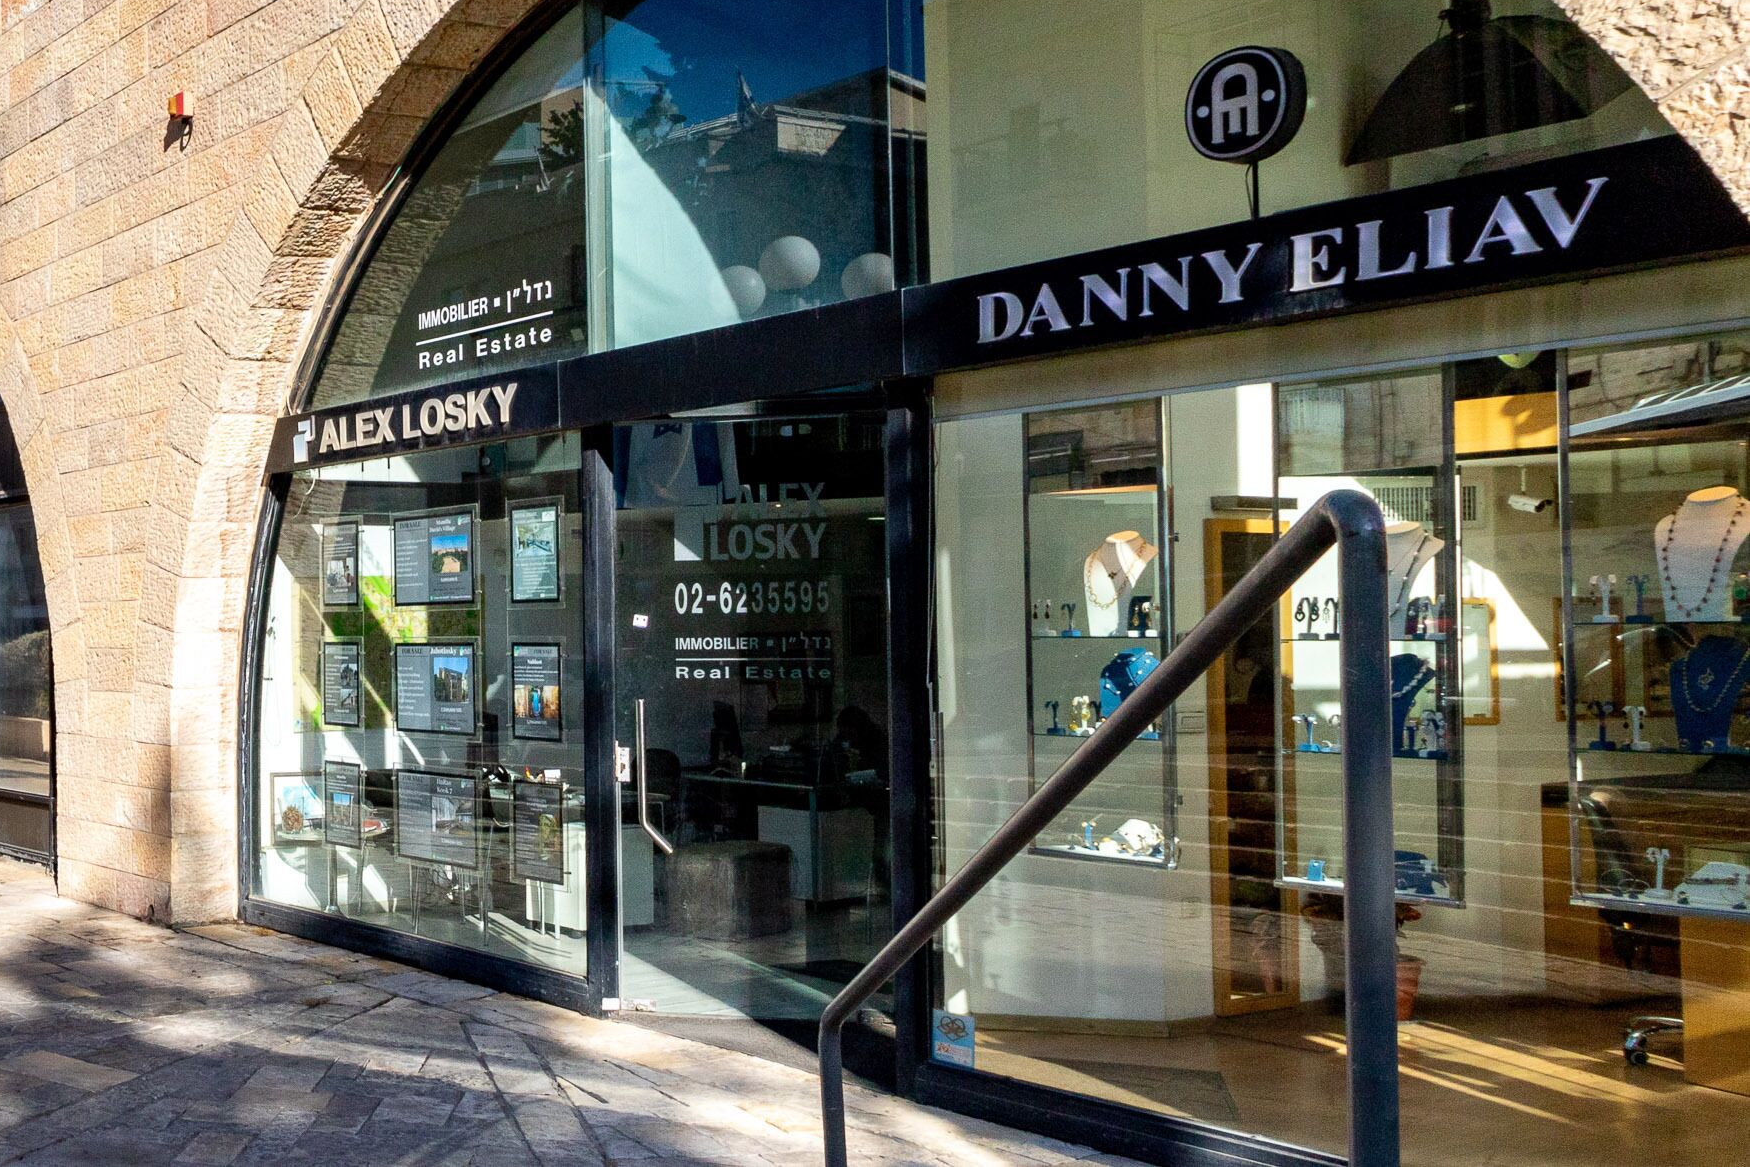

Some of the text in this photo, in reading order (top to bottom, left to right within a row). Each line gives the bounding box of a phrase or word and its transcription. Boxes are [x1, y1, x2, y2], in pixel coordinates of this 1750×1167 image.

[977, 177, 1609, 345] DANNY ELIAV
[418, 296, 488, 331] IMMOBILIER
[419, 327, 552, 369] Real Estate
[319, 383, 518, 454] ALEX LOSKY
[731, 482, 826, 520] ALEX
[710, 522, 827, 561] LOSKY
[674, 581, 829, 615] 02-6235595
[675, 637, 759, 650] IMMOBILIER
[675, 666, 831, 680] Real Estate
